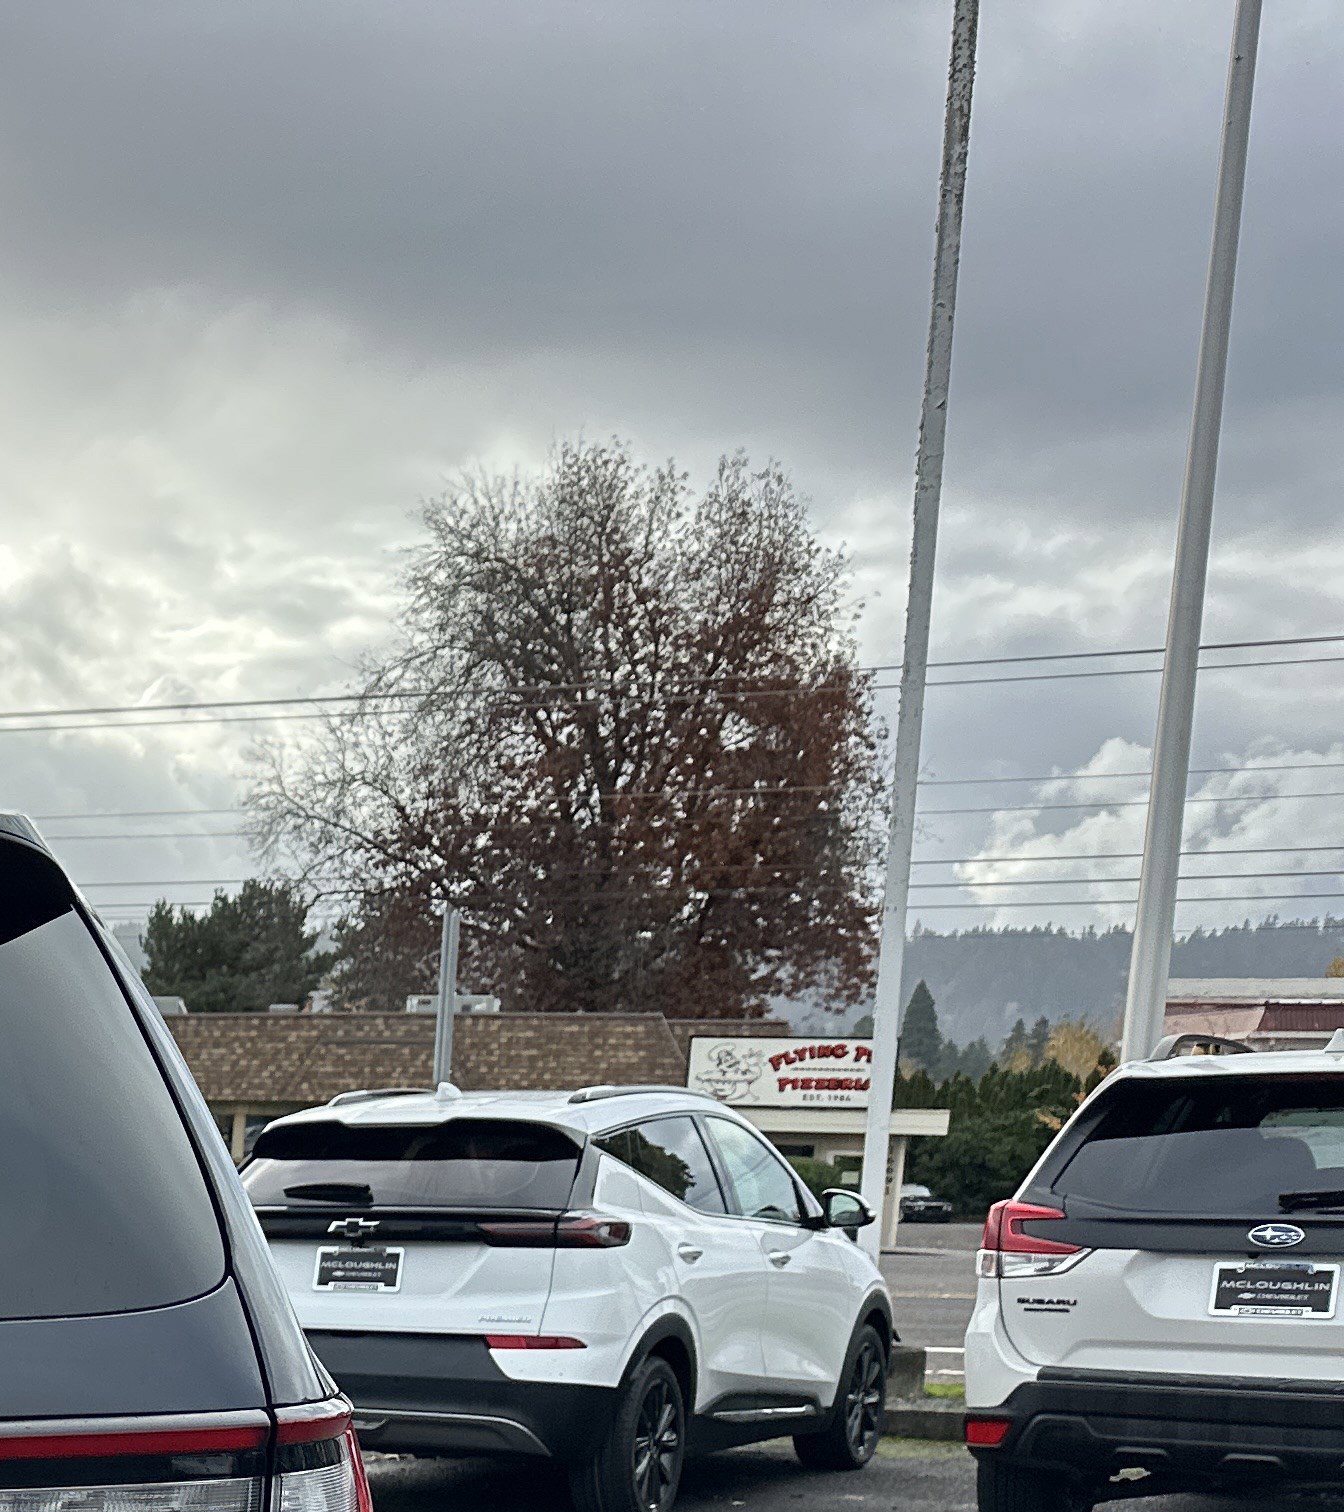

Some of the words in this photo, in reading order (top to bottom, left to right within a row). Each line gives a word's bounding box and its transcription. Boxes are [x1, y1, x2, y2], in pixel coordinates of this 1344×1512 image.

[769, 1044, 849, 1072] FLYING
[854, 1045, 872, 1063] PI
[1220, 1280, 1331, 1291] MCLOUGHLIN
[1017, 1297, 1077, 1306] SUBARU
